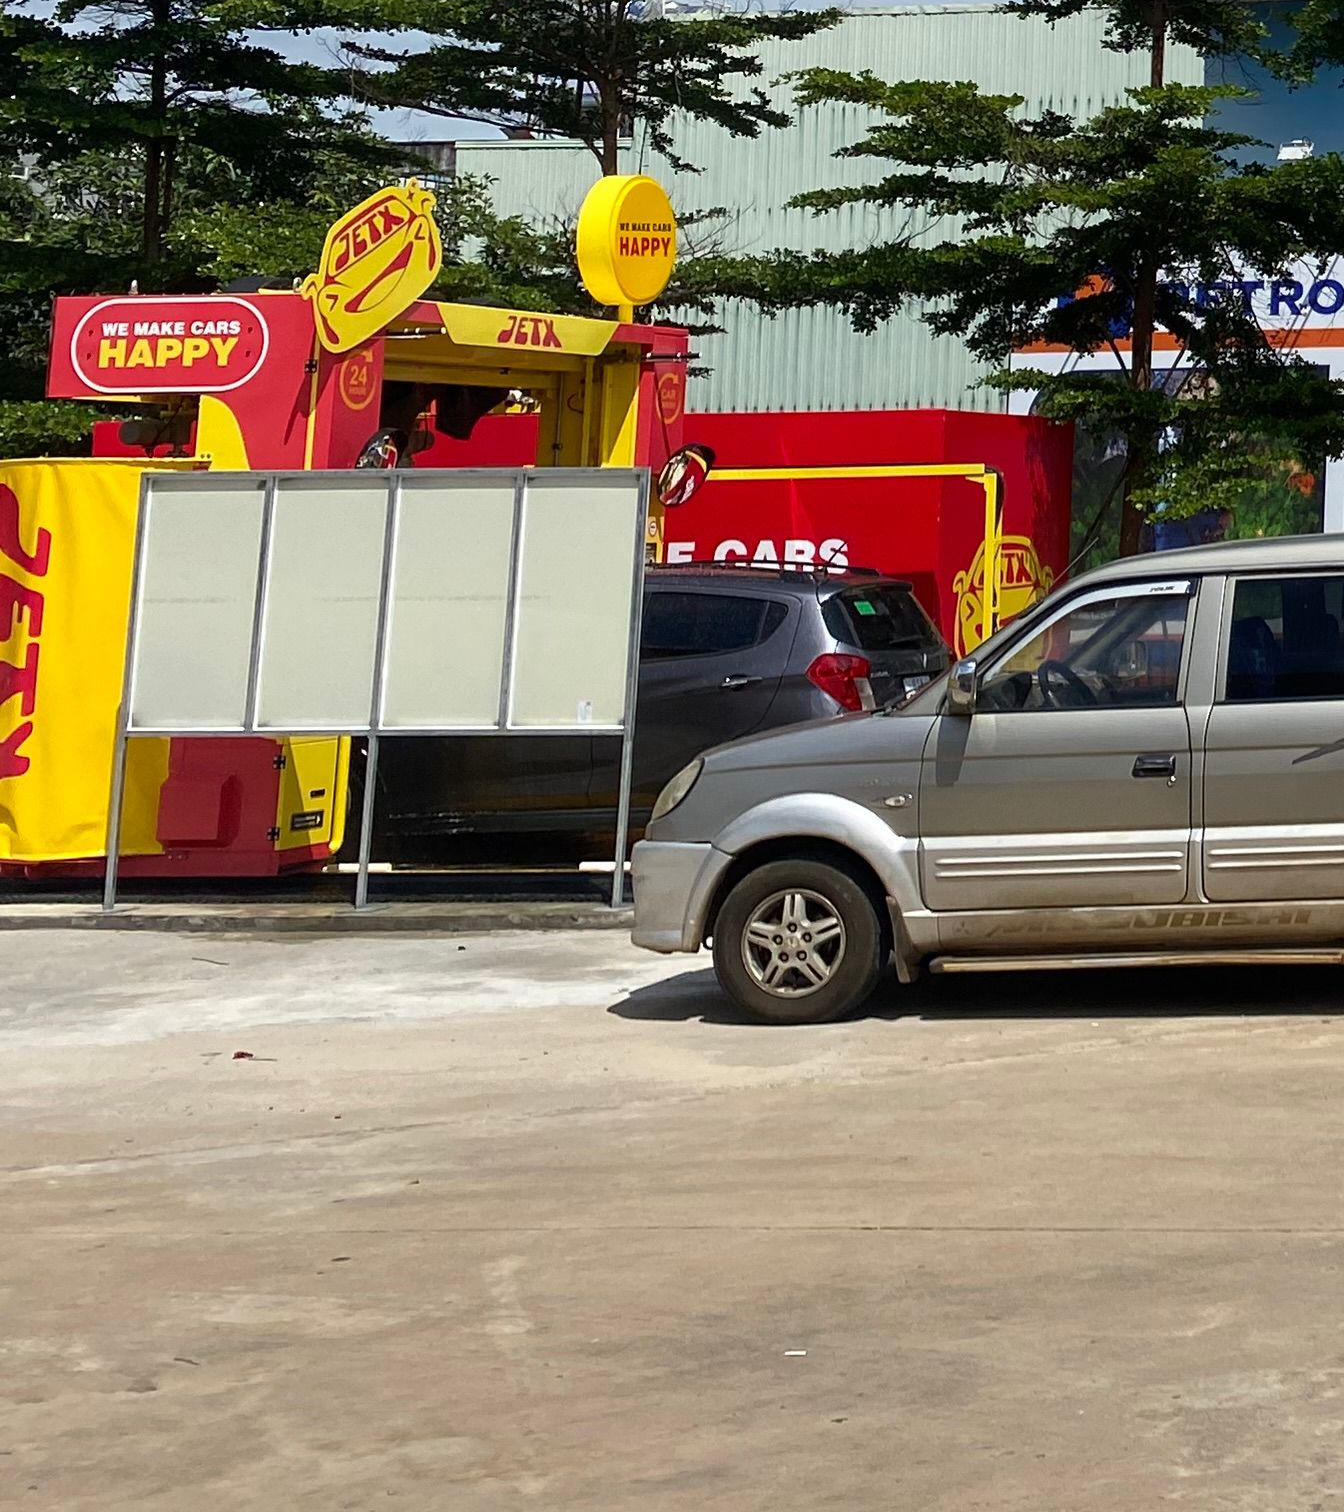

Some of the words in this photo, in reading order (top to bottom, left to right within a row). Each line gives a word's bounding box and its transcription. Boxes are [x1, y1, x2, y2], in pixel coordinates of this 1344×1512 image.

[335, 205, 405, 273] JETX
[619, 237, 671, 257] HAPPY
[101, 322, 129, 337] WE
[133, 321, 186, 336] MAKE
[190, 320, 241, 335] CARS
[496, 315, 563, 349] JETX
[97, 337, 239, 368] HAPPY
[349, 365, 367, 386] 24
[713, 538, 849, 575] CARS
